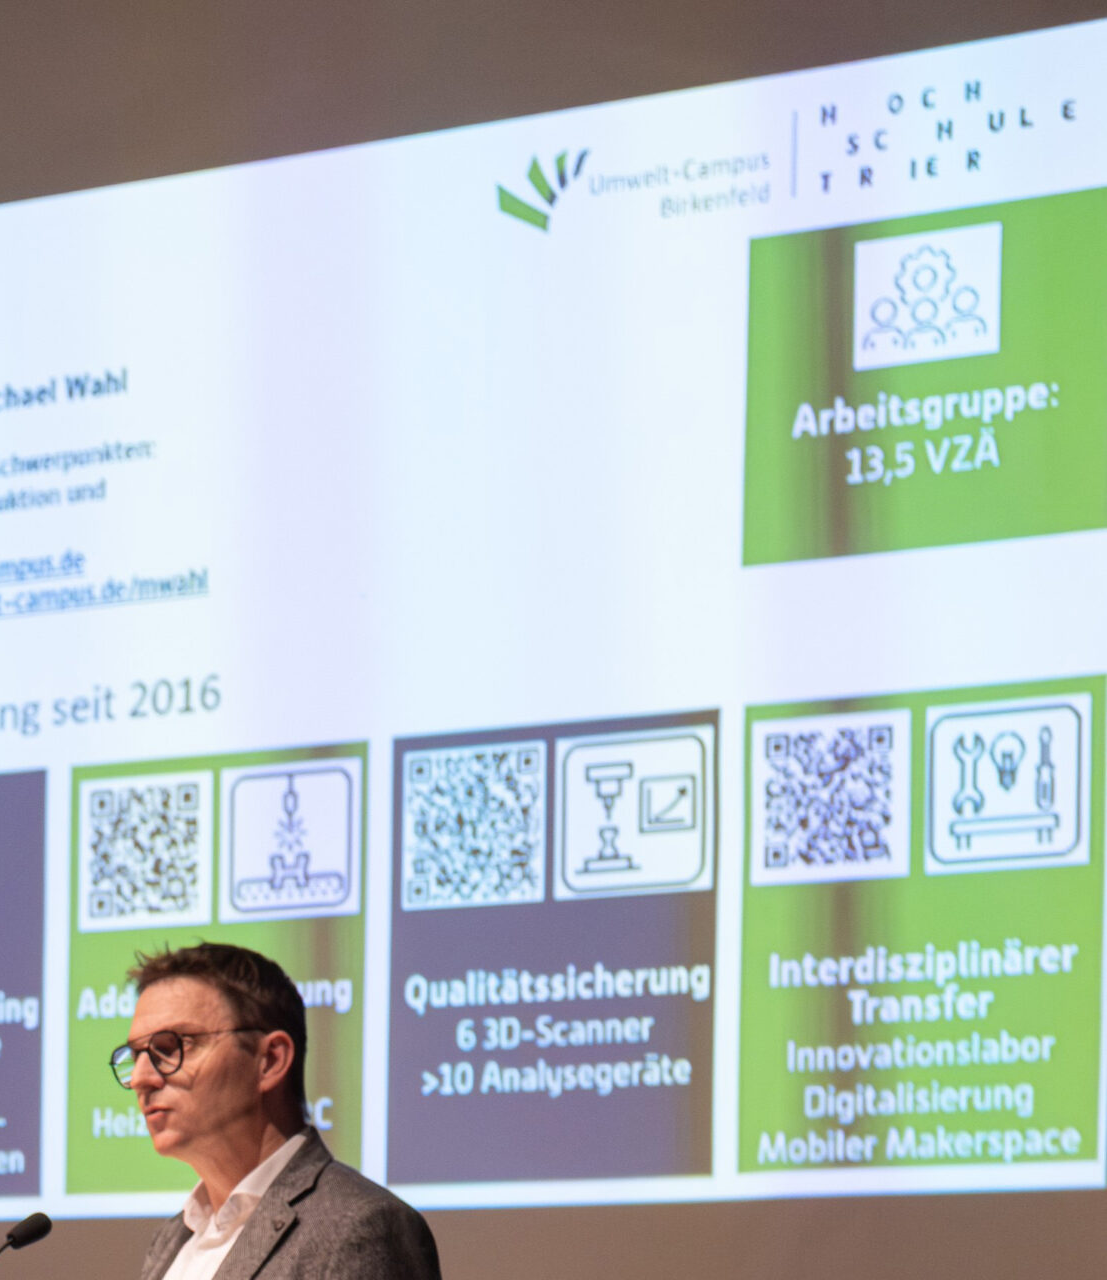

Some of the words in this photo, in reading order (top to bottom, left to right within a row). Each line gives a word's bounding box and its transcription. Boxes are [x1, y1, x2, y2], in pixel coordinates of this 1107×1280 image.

[660, 184, 770, 220] Birkenfeld
[65, 367, 128, 400] Wahl
[792, 382, 1060, 440] Arbeitsgruppe:
[845, 440, 916, 487] 13,5
[925, 426, 1001, 475] VZÄ
[67, 479, 107, 503] und
[52, 684, 115, 724] seit
[130, 674, 221, 719] 2016
[769, 938, 1079, 989] Interdisziplinärer
[404, 961, 711, 1017] Qualitätssicherung
[847, 982, 994, 1026] Transfer
[456, 1018, 477, 1052] 6
[483, 1014, 655, 1051] 3D-Scanner
[787, 1029, 1056, 1073] Innovationslabor
[421, 1061, 475, 1097] >10
[480, 1052, 693, 1099] Analysegeräte
[803, 1079, 1034, 1125] Digitalisierung
[758, 1128, 878, 1165] Mobiler
[886, 1125, 1082, 1164] Makerspace
